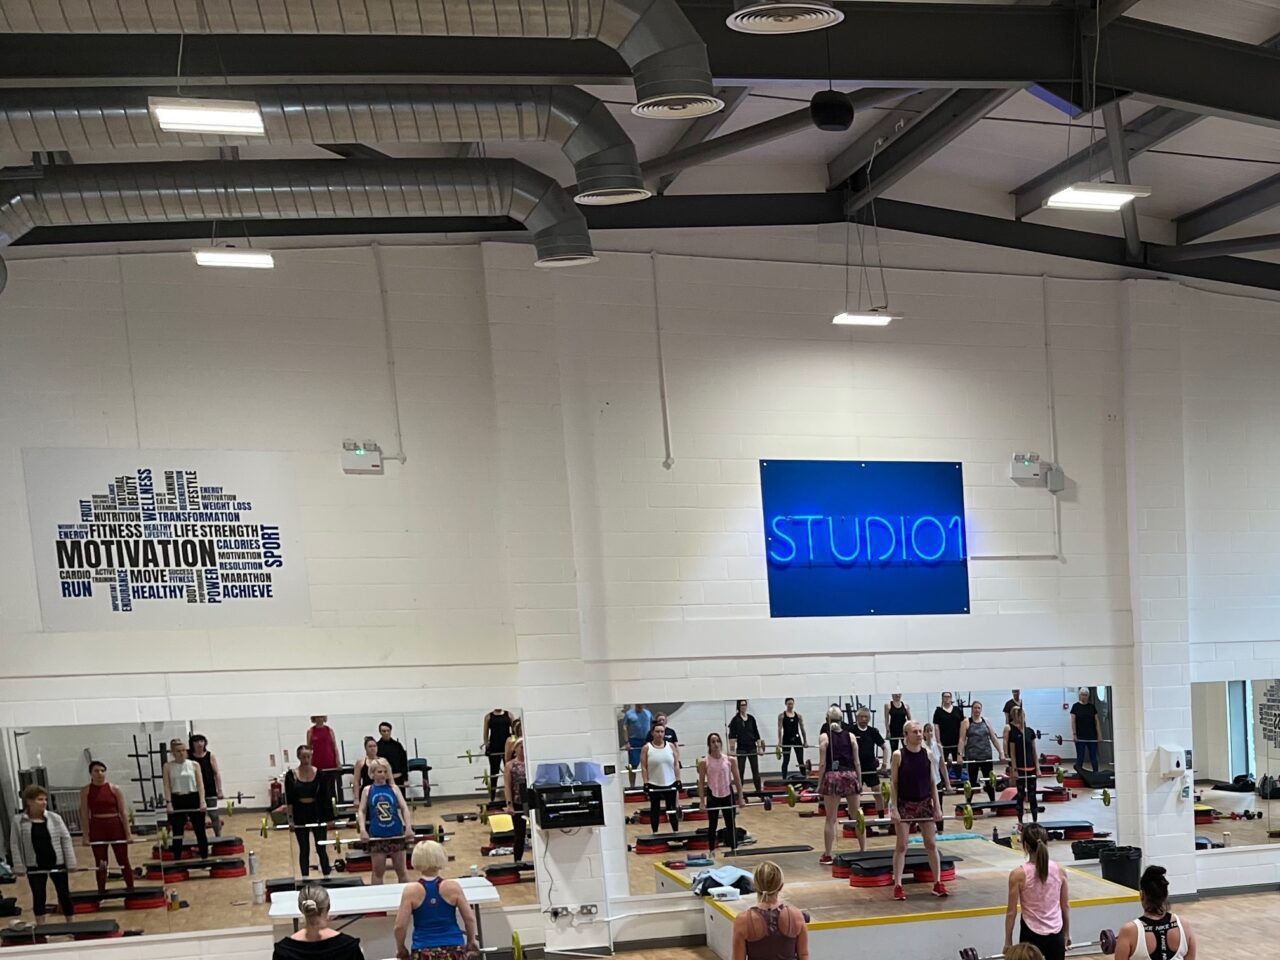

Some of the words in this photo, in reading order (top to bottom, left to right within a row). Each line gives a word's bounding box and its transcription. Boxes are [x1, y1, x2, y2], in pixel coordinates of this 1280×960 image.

[115, 476, 127, 506] NATURAL
[125, 476, 139, 506] BEAUTY
[137, 469, 157, 521] WELLNESS
[185, 471, 200, 510] LIFESTYLE
[79, 500, 94, 522] FRUIT
[202, 502, 230, 510] WEIGHT
[233, 502, 251, 510] LOSS
[94, 512, 141, 522] NUTRITION
[158, 512, 240, 522] TRANSFORMATION
[59, 531, 88, 539] ENERGY
[89, 524, 142, 538] FITNESS
[174, 524, 199, 537] LIFE
[200, 525, 258, 537] STRENGTH
[217, 539, 260, 549] CALORIES
[260, 525, 282, 568] SPORT
[56, 540, 216, 569] MOTIVATION
[219, 562, 262, 570] RESOLUTION
[60, 570, 91, 579] CARDIO
[130, 569, 167, 583] MOVE
[169, 575, 194, 583] FITNESS
[221, 573, 271, 583] MARATHON
[61, 581, 92, 597] RUN
[117, 570, 132, 612] ENDURANCE
[132, 585, 183, 599] HEALTHY
[204, 568, 222, 603] POWER
[223, 585, 273, 598] ACHIEVE
[186, 585, 197, 603] BODY
